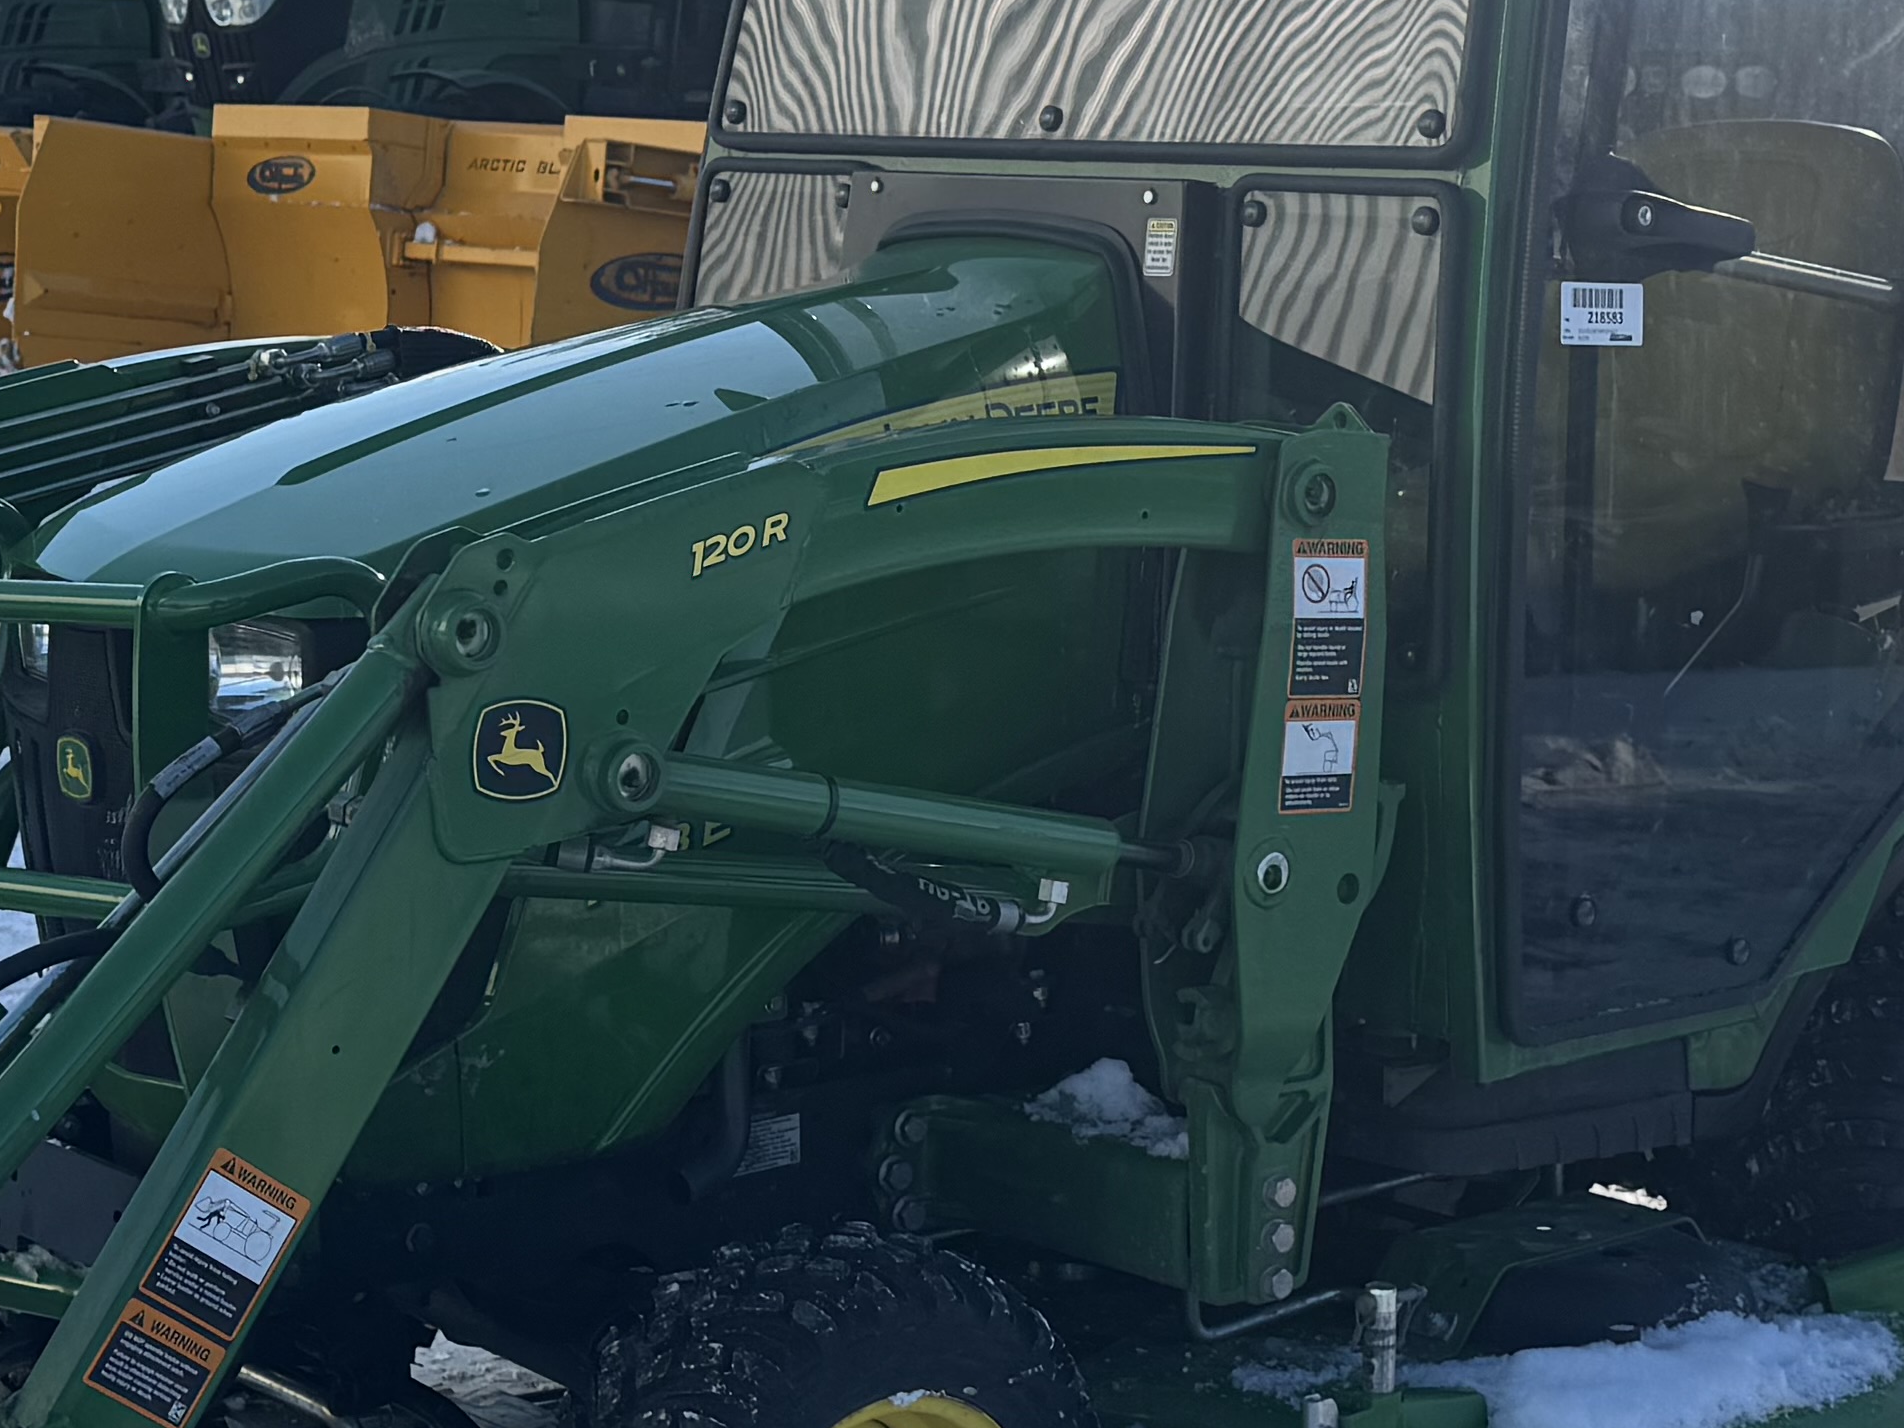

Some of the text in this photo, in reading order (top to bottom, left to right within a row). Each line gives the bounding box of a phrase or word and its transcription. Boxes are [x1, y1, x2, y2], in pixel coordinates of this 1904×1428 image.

[467, 157, 527, 173] ARCTIC
[691, 525, 757, 578] 120
[1307, 541, 1365, 555] WARNING
[1301, 703, 1356, 718] WARNING
[237, 1165, 297, 1211] WARNING
[150, 1319, 211, 1362] WARNING
